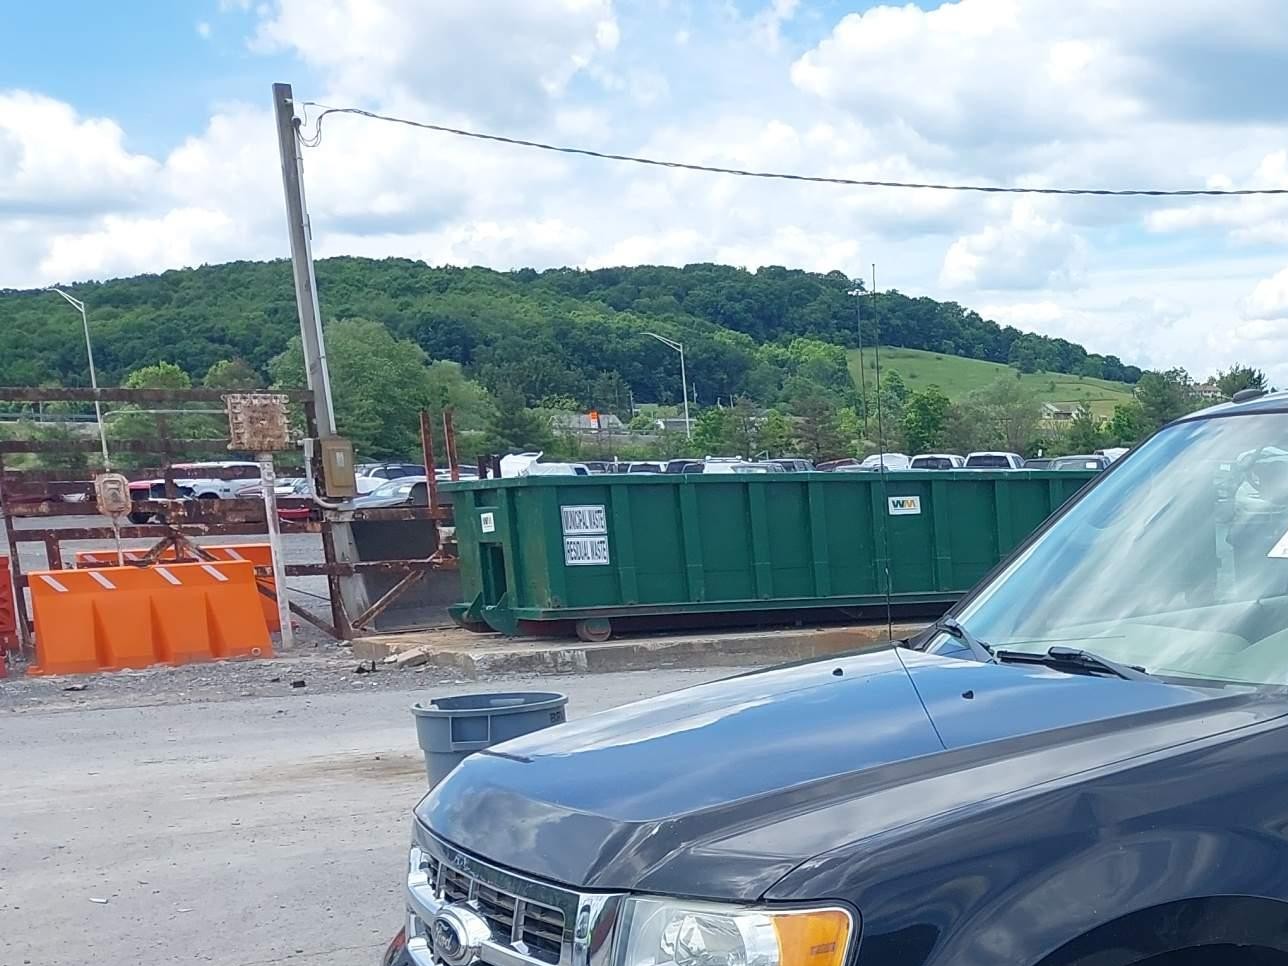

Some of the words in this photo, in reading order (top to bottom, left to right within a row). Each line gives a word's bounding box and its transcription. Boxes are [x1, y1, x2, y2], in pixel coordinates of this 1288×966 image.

[891, 499, 916, 508] WM
[563, 510, 589, 529] MUNICIPAL
[589, 510, 605, 529] WASTE
[566, 541, 590, 560] RESIDUAL
[590, 540, 607, 560] WASTE
